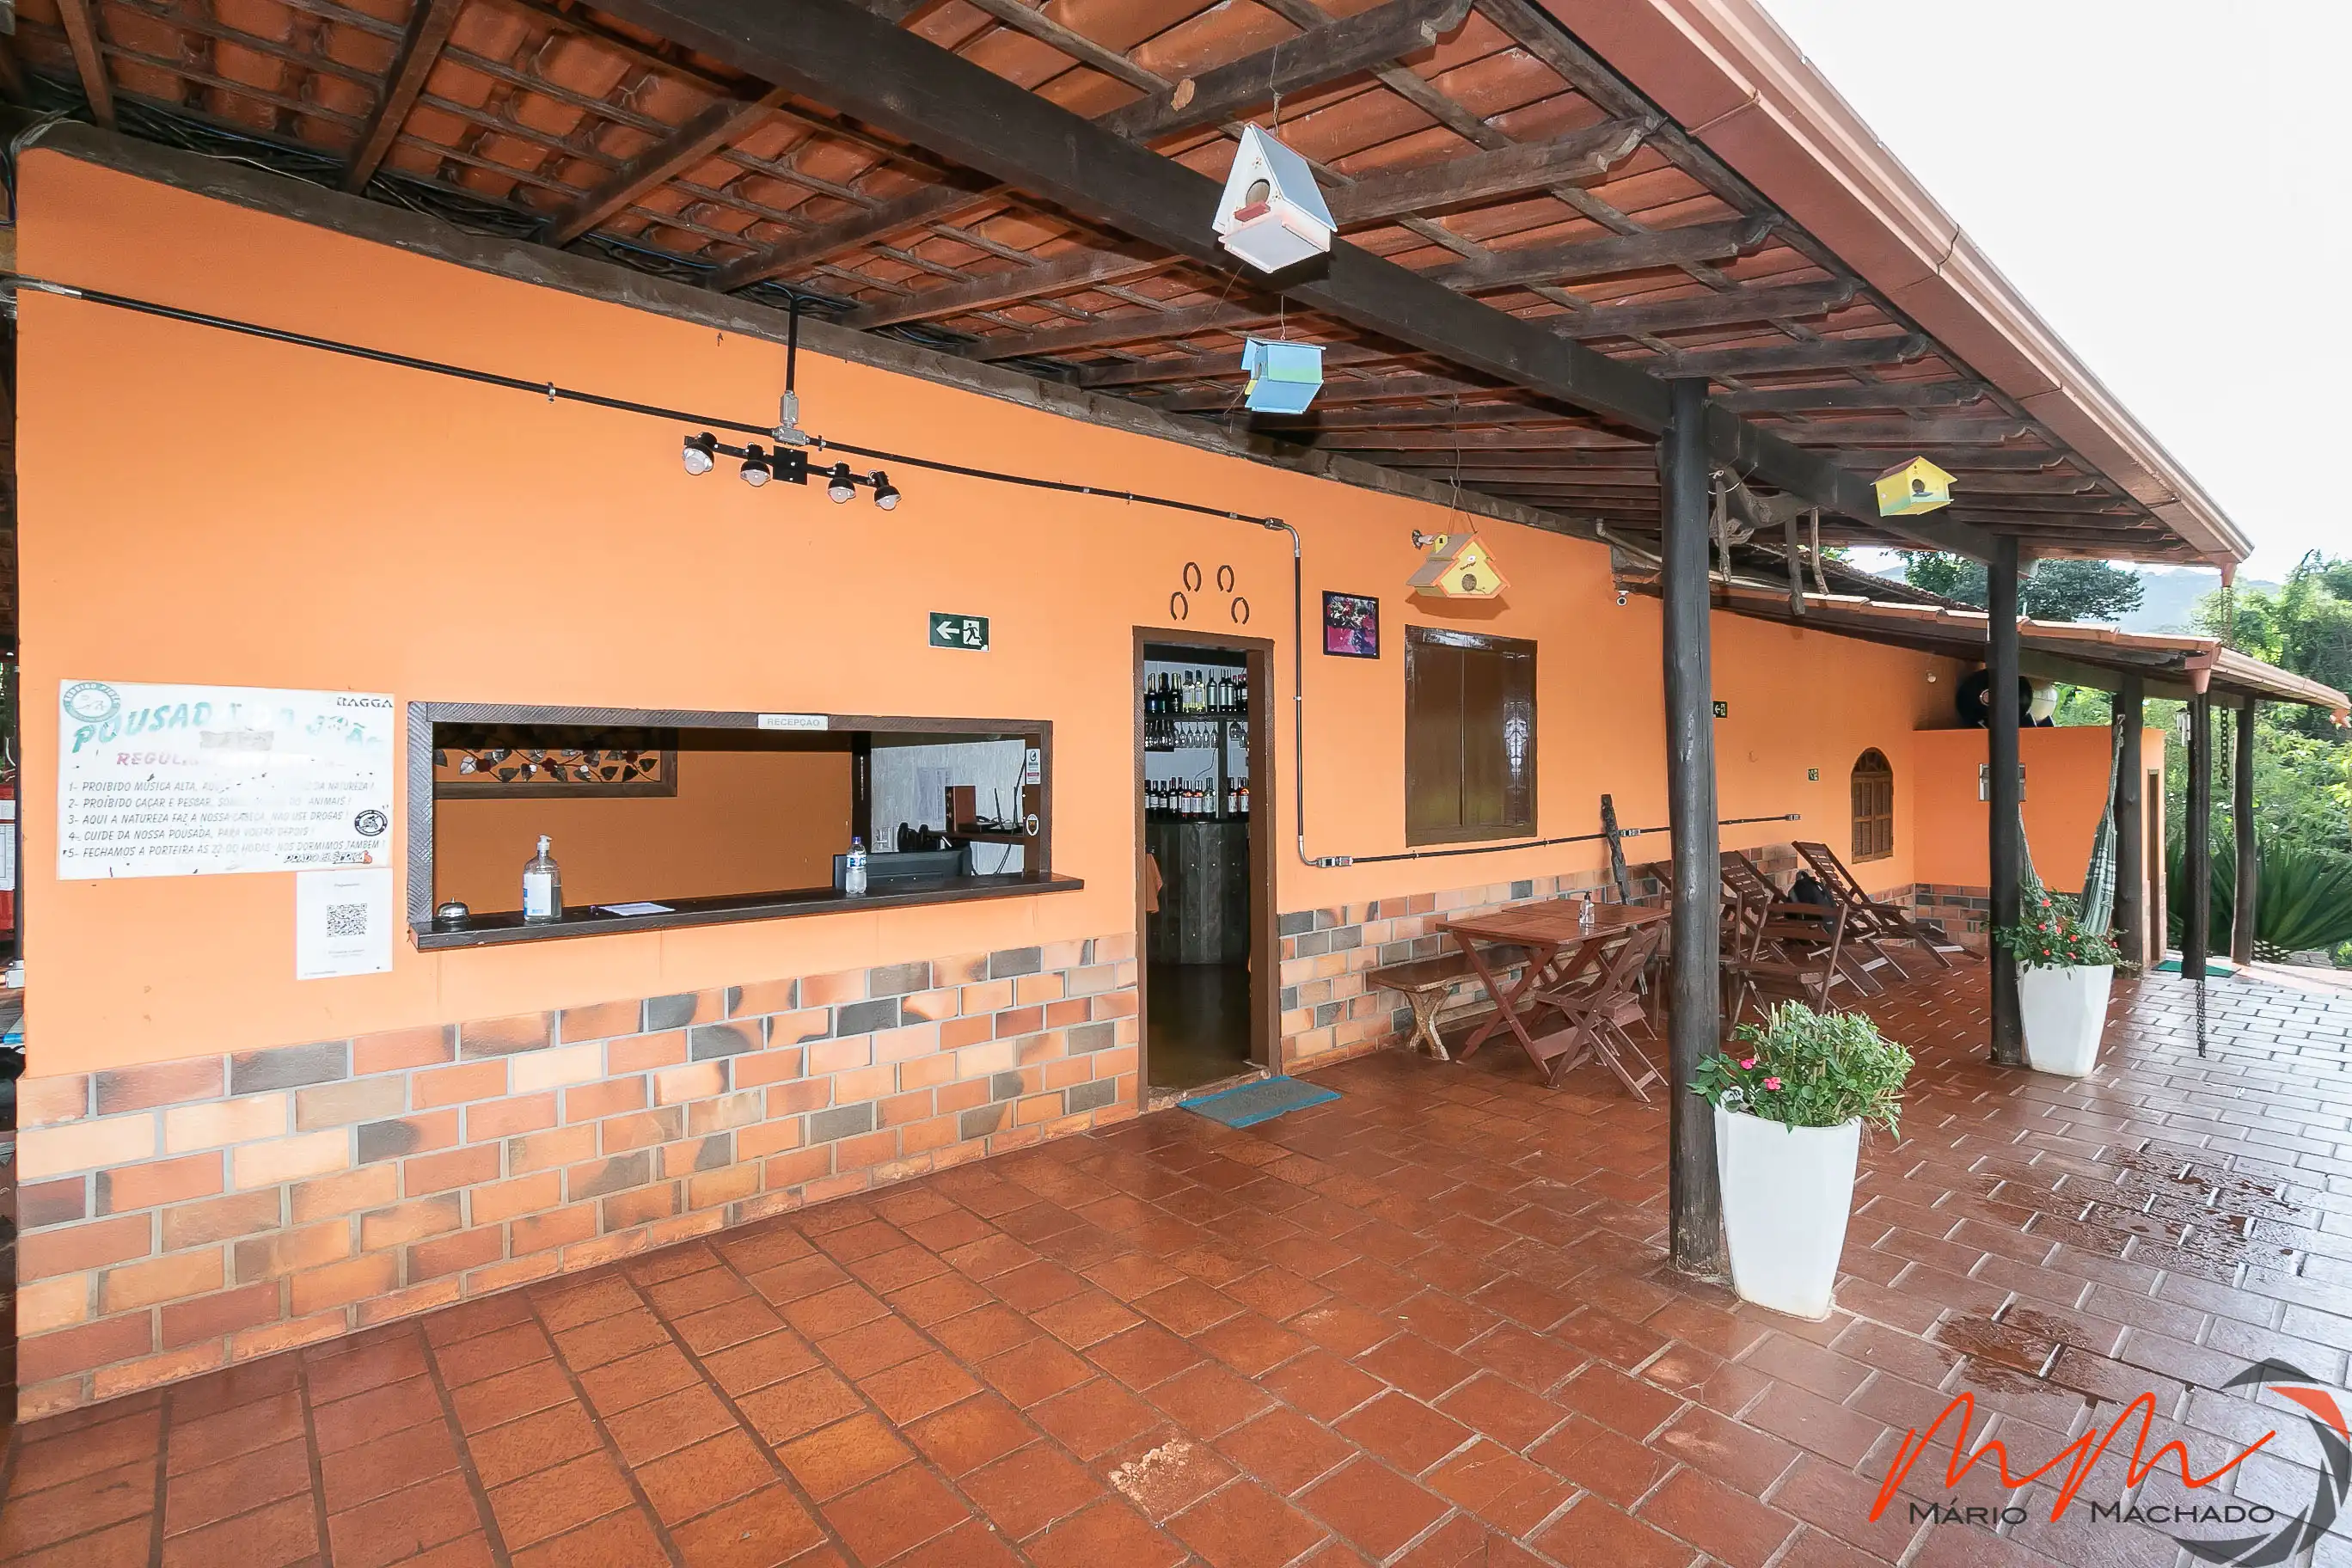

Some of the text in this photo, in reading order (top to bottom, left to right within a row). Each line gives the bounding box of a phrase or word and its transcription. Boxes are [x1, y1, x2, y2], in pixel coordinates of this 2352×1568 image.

[336, 696, 394, 708] RAGGA
[767, 717, 820, 727] RECEPÇÃO
[82, 781, 132, 792] PROIBIDO
[328, 781, 368, 791] NATUREZA
[83, 798, 132, 809] PROIBIDO
[135, 798, 166, 810] CAÇAR
[168, 798, 176, 808] E
[309, 795, 346, 805] ANIMAIS
[83, 815, 107, 824] AQUI
[110, 815, 118, 824] A
[120, 814, 168, 824] NATUREZA
[171, 813, 187, 823] FAZ
[190, 813, 197, 823] A
[200, 812, 230, 823] NOSSA
[291, 811, 308, 821] USE
[310, 811, 344, 821] DROGAS
[84, 830, 114, 841] CUIDE
[117, 830, 130, 840] DA
[133, 830, 164, 840] NOSSA
[217, 827, 240, 838] PARA
[277, 826, 309, 836] DEPOIS
[83, 846, 136, 858] FECHAMOS
[138, 846, 144, 856] A
[149, 845, 193, 856] PORTEIRA
[297, 840, 344, 851] DORMIMOS
